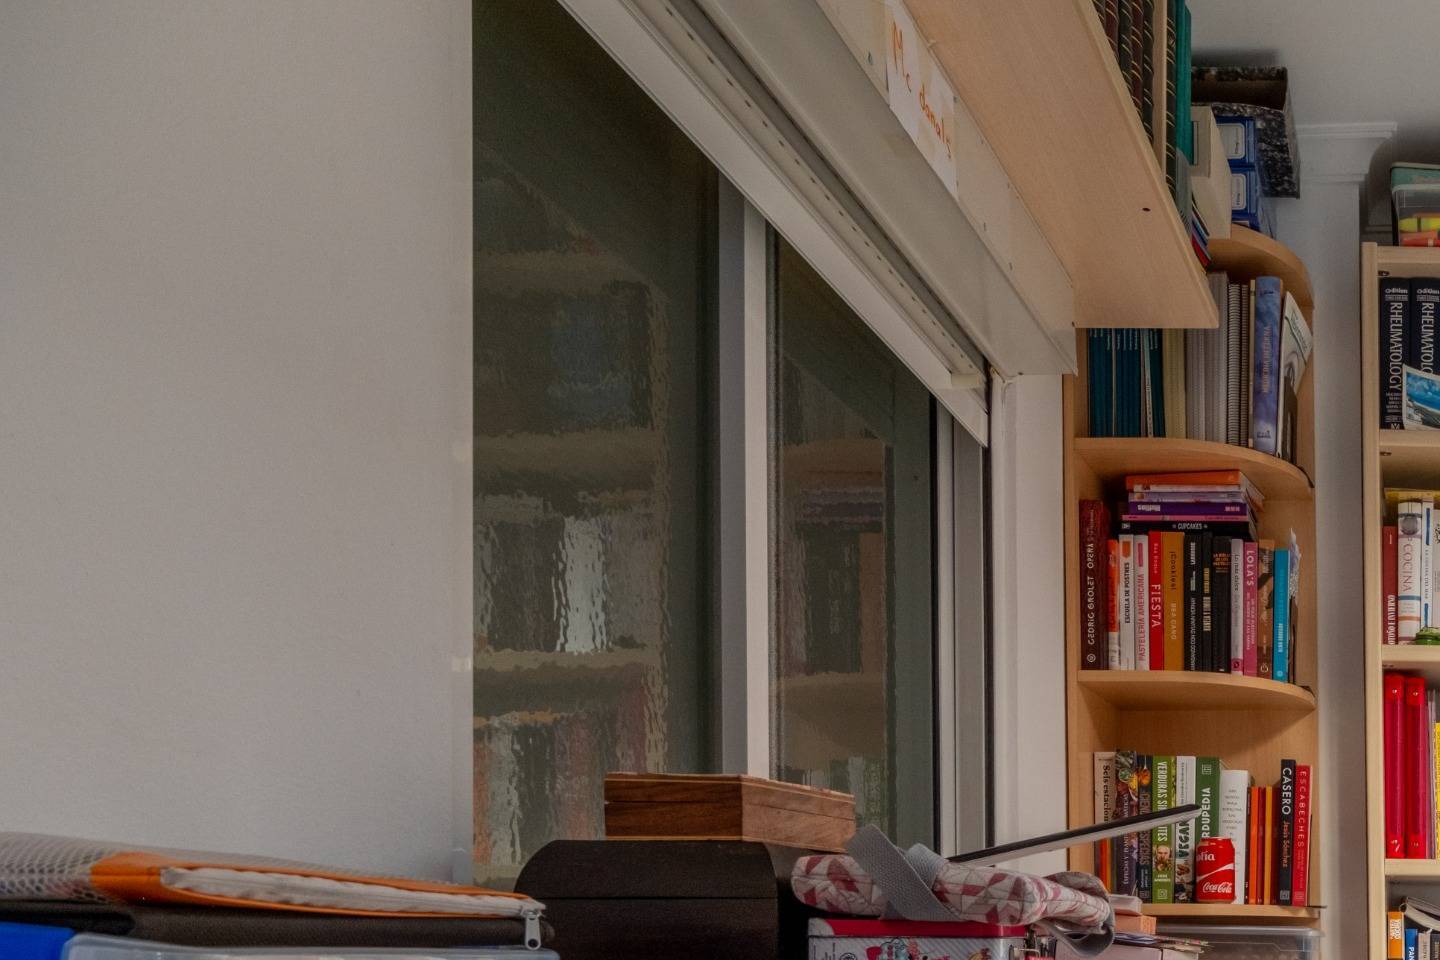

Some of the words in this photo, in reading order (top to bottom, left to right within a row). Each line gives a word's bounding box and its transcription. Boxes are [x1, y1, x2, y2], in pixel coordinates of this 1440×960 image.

[1389, 302, 1403, 396] RHEUMATOLOGY
[1246, 550, 1255, 586] LOLA'S
[1402, 544, 1413, 592] COCINA
[1152, 584, 1162, 628] FIESTA
[1103, 765, 1111, 783] Seis
[1157, 761, 1168, 798] VERDURAS
[1281, 767, 1292, 815] CASERO
[1103, 785, 1111, 822] estacion
[1201, 786, 1211, 839] RDUPEDIA
[1297, 770, 1307, 848] ESCABECHES
